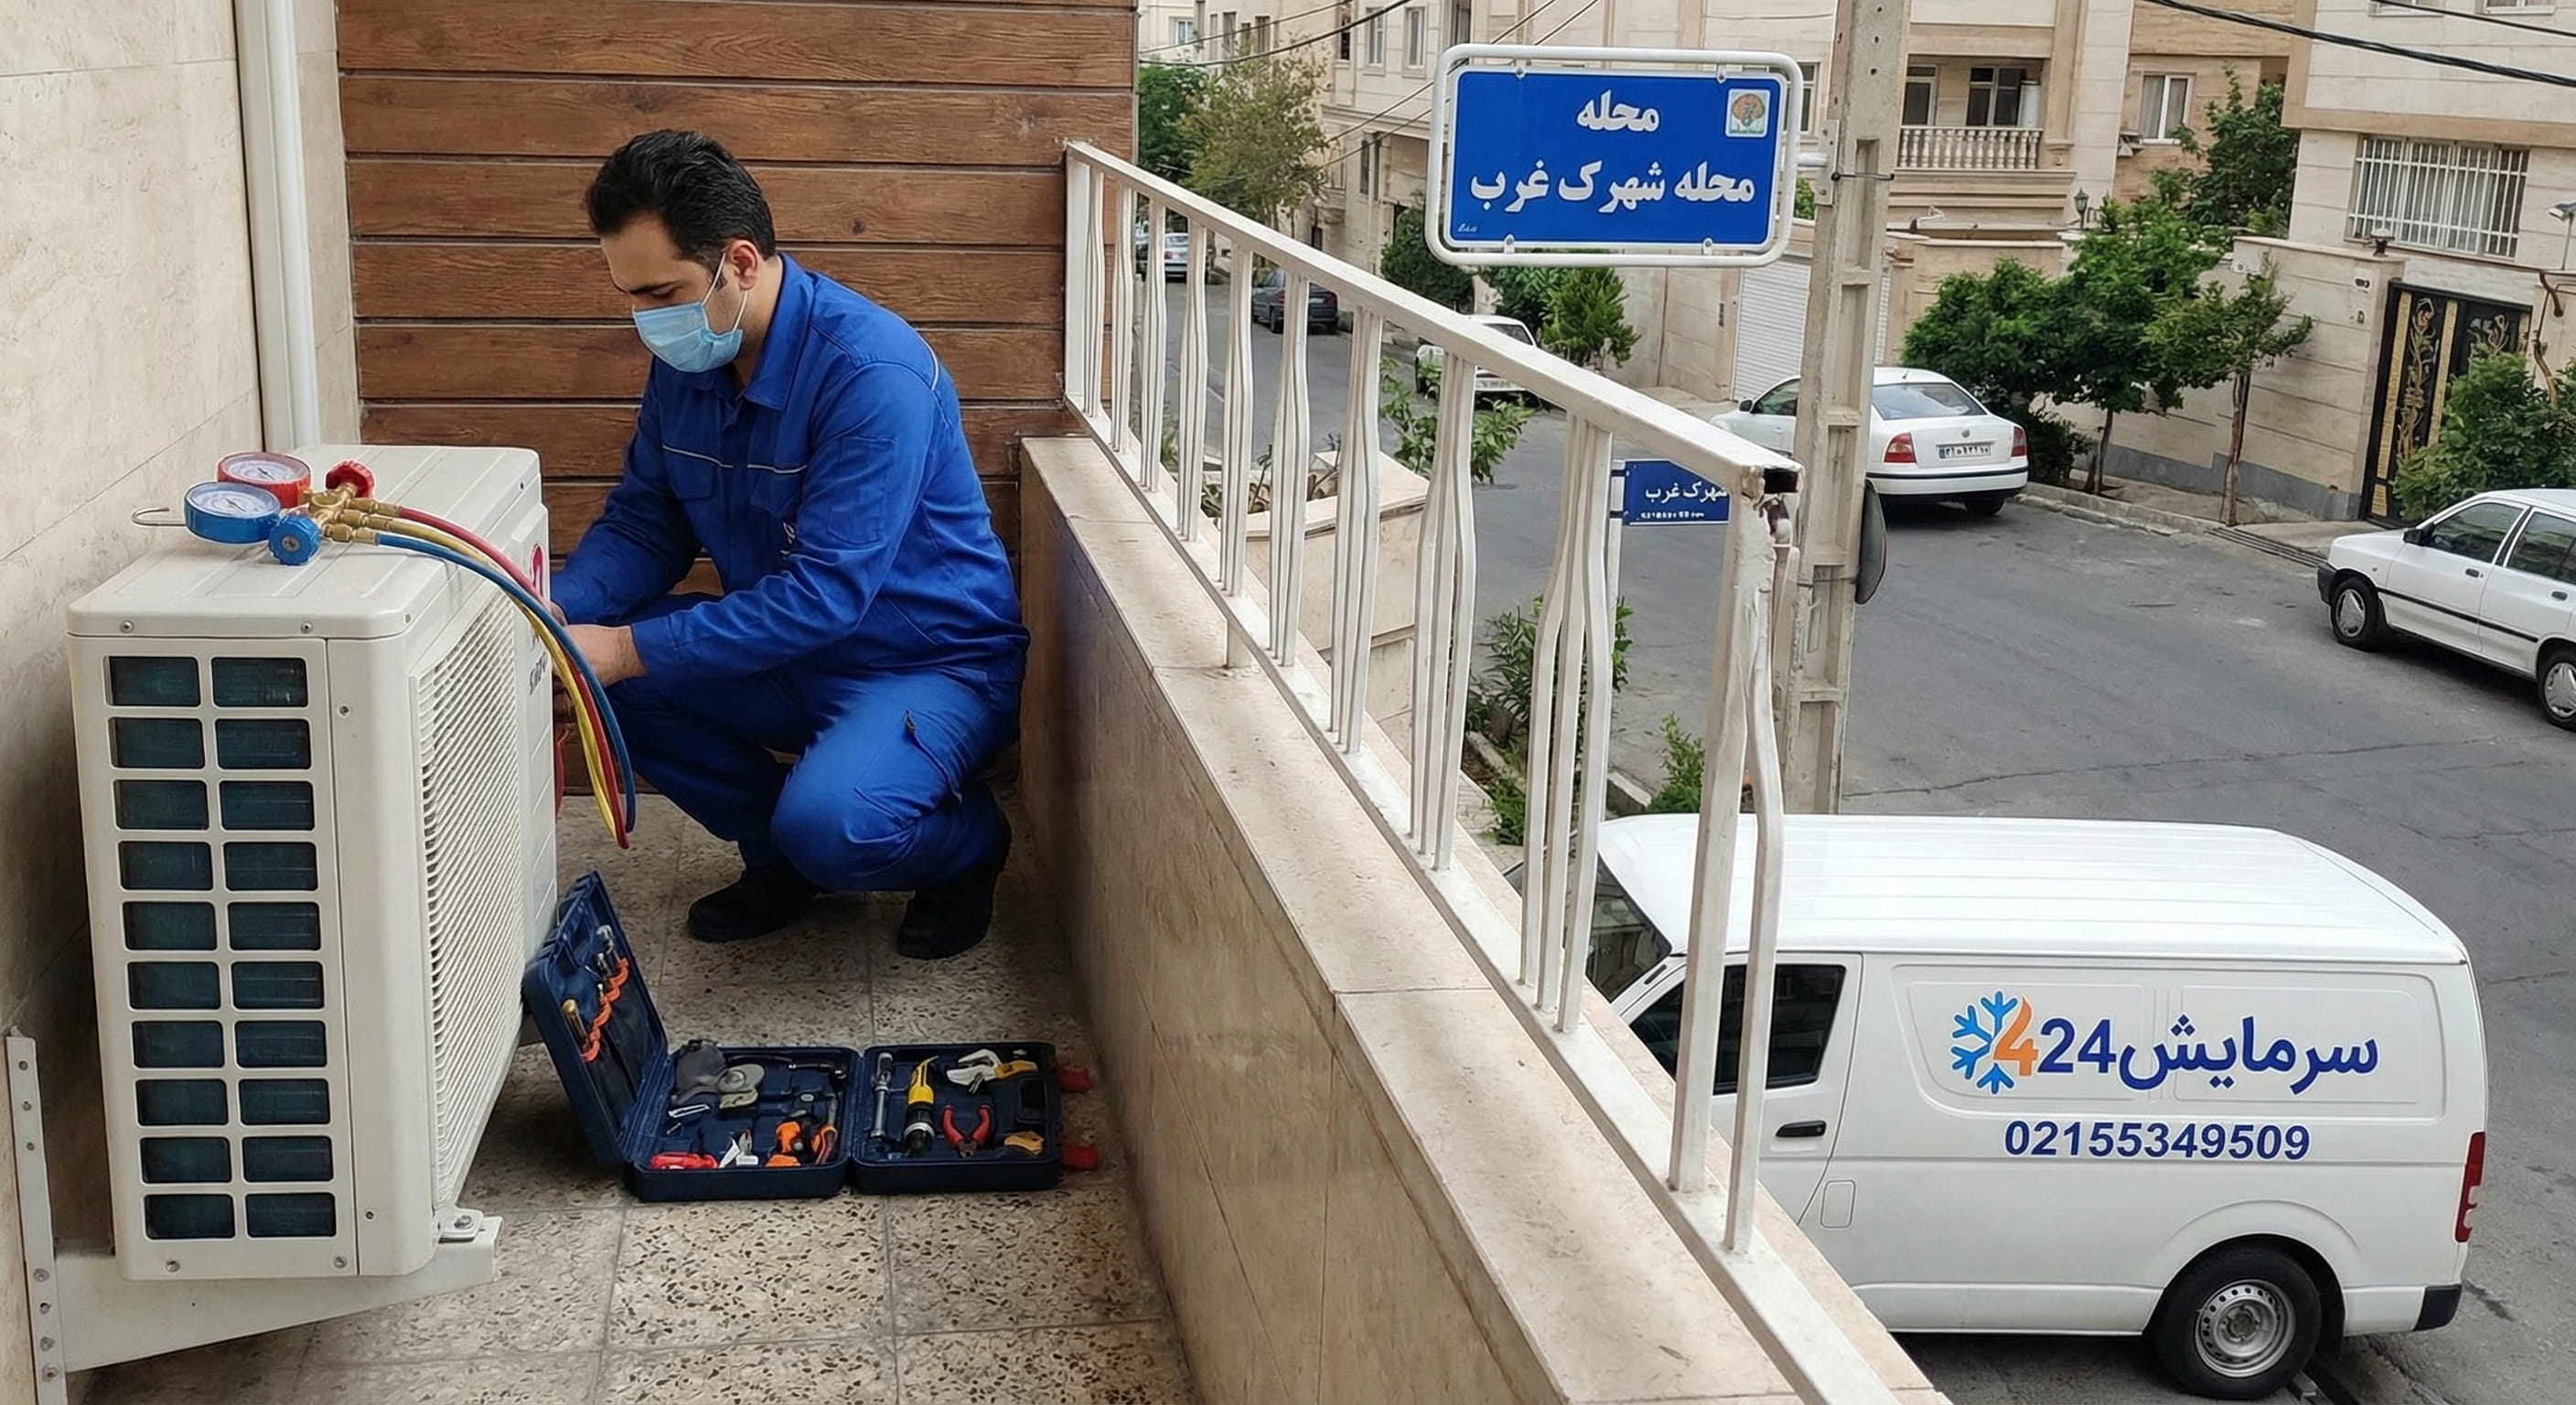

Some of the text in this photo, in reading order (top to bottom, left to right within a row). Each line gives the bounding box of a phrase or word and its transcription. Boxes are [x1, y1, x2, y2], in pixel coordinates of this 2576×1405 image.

[1577, 90, 1659, 132] محله
[1470, 159, 1755, 213] محله شهرک غرب
[1645, 481, 1680, 504] غرب
[2004, 1121, 2311, 1160] 02155349509
